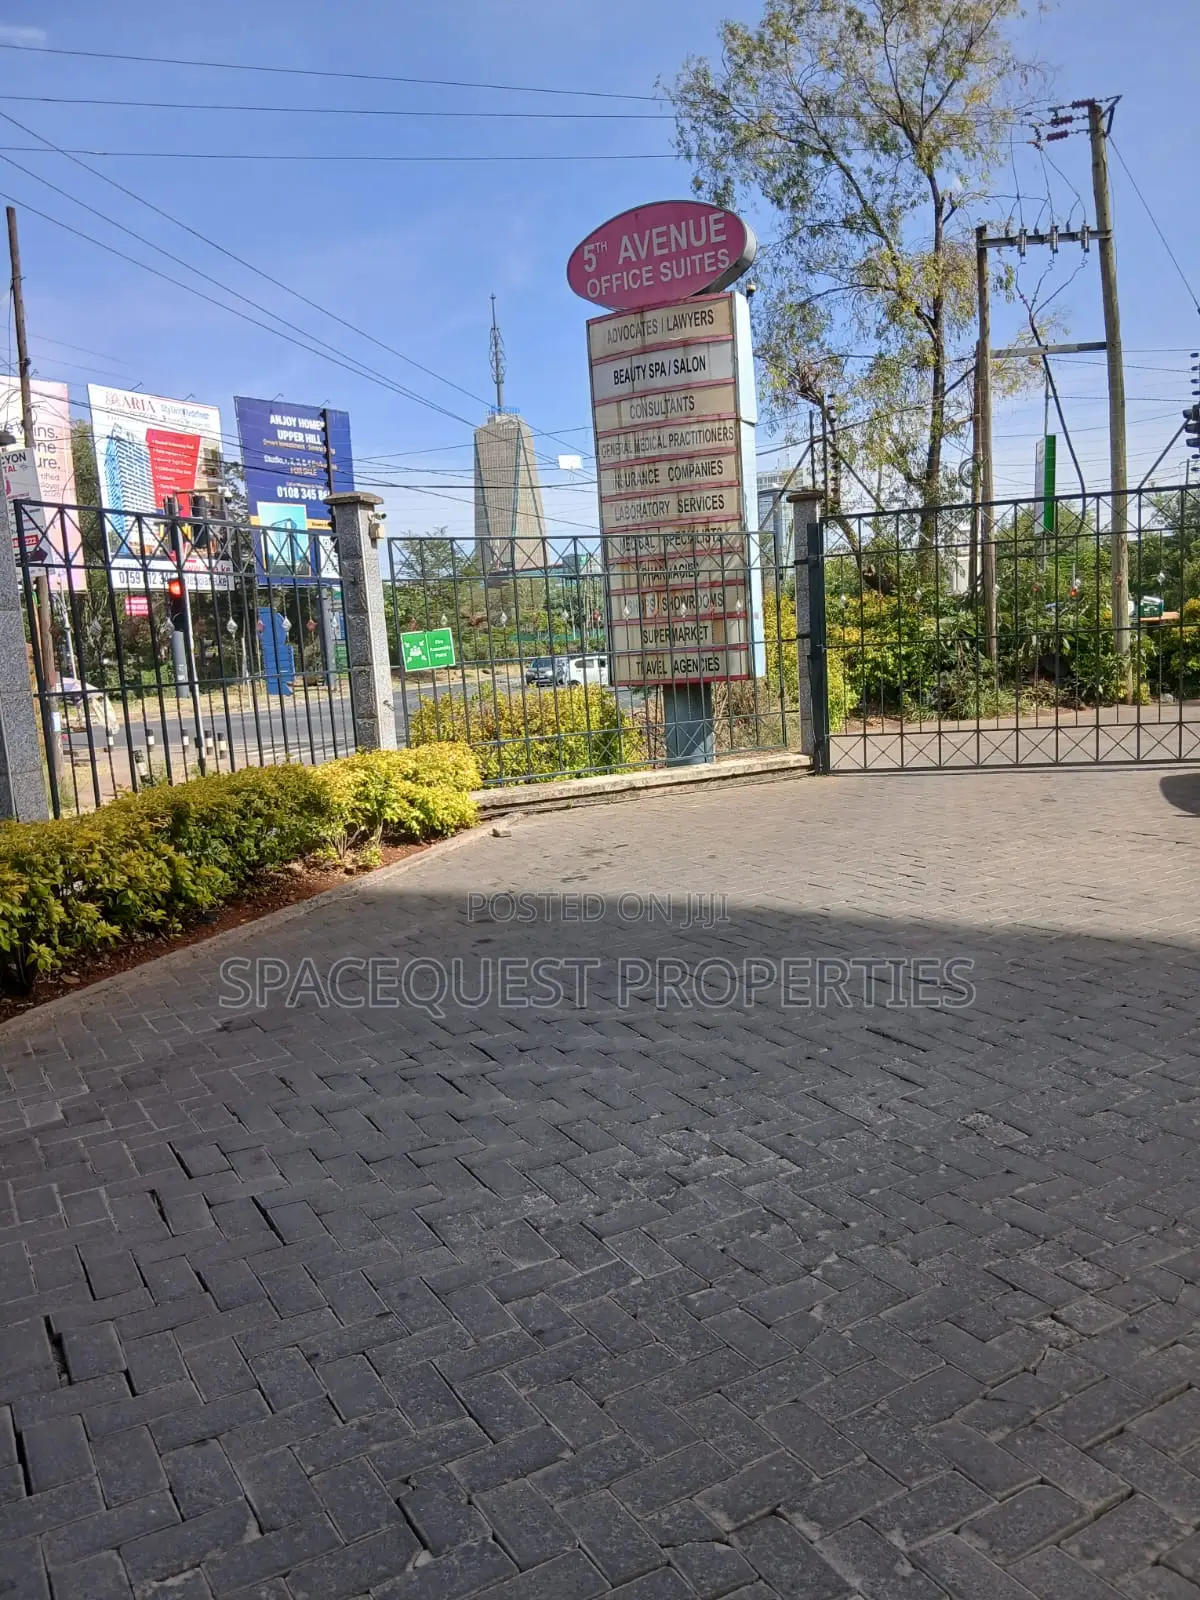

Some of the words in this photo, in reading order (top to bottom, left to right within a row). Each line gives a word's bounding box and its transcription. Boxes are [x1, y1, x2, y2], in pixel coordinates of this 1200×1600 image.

[618, 212, 727, 265] AVENUE
[586, 265, 654, 298] OFFICE
[660, 248, 730, 282] SUITES
[607, 318, 658, 345] ADVOCATES
[667, 309, 714, 332] LAWYERS
[613, 364, 647, 386] BEAUTY
[648, 362, 666, 379] SPA
[673, 355, 706, 375] SALON
[630, 395, 695, 419] CONSULTANTS
[277, 429, 305, 443] UPPER
[305, 433, 323, 446] HILL
[634, 435, 667, 452] MEDICAL
[668, 426, 734, 448] PRACTITIONERS
[668, 460, 723, 482] COMPANIES
[277, 486, 300, 499] 0108
[301, 488, 317, 500] 345
[614, 501, 670, 522] LABORATORY
[677, 494, 725, 514] SERVICES
[642, 625, 708, 644] SUPERMARKET
[674, 656, 720, 674] AGENCIES
